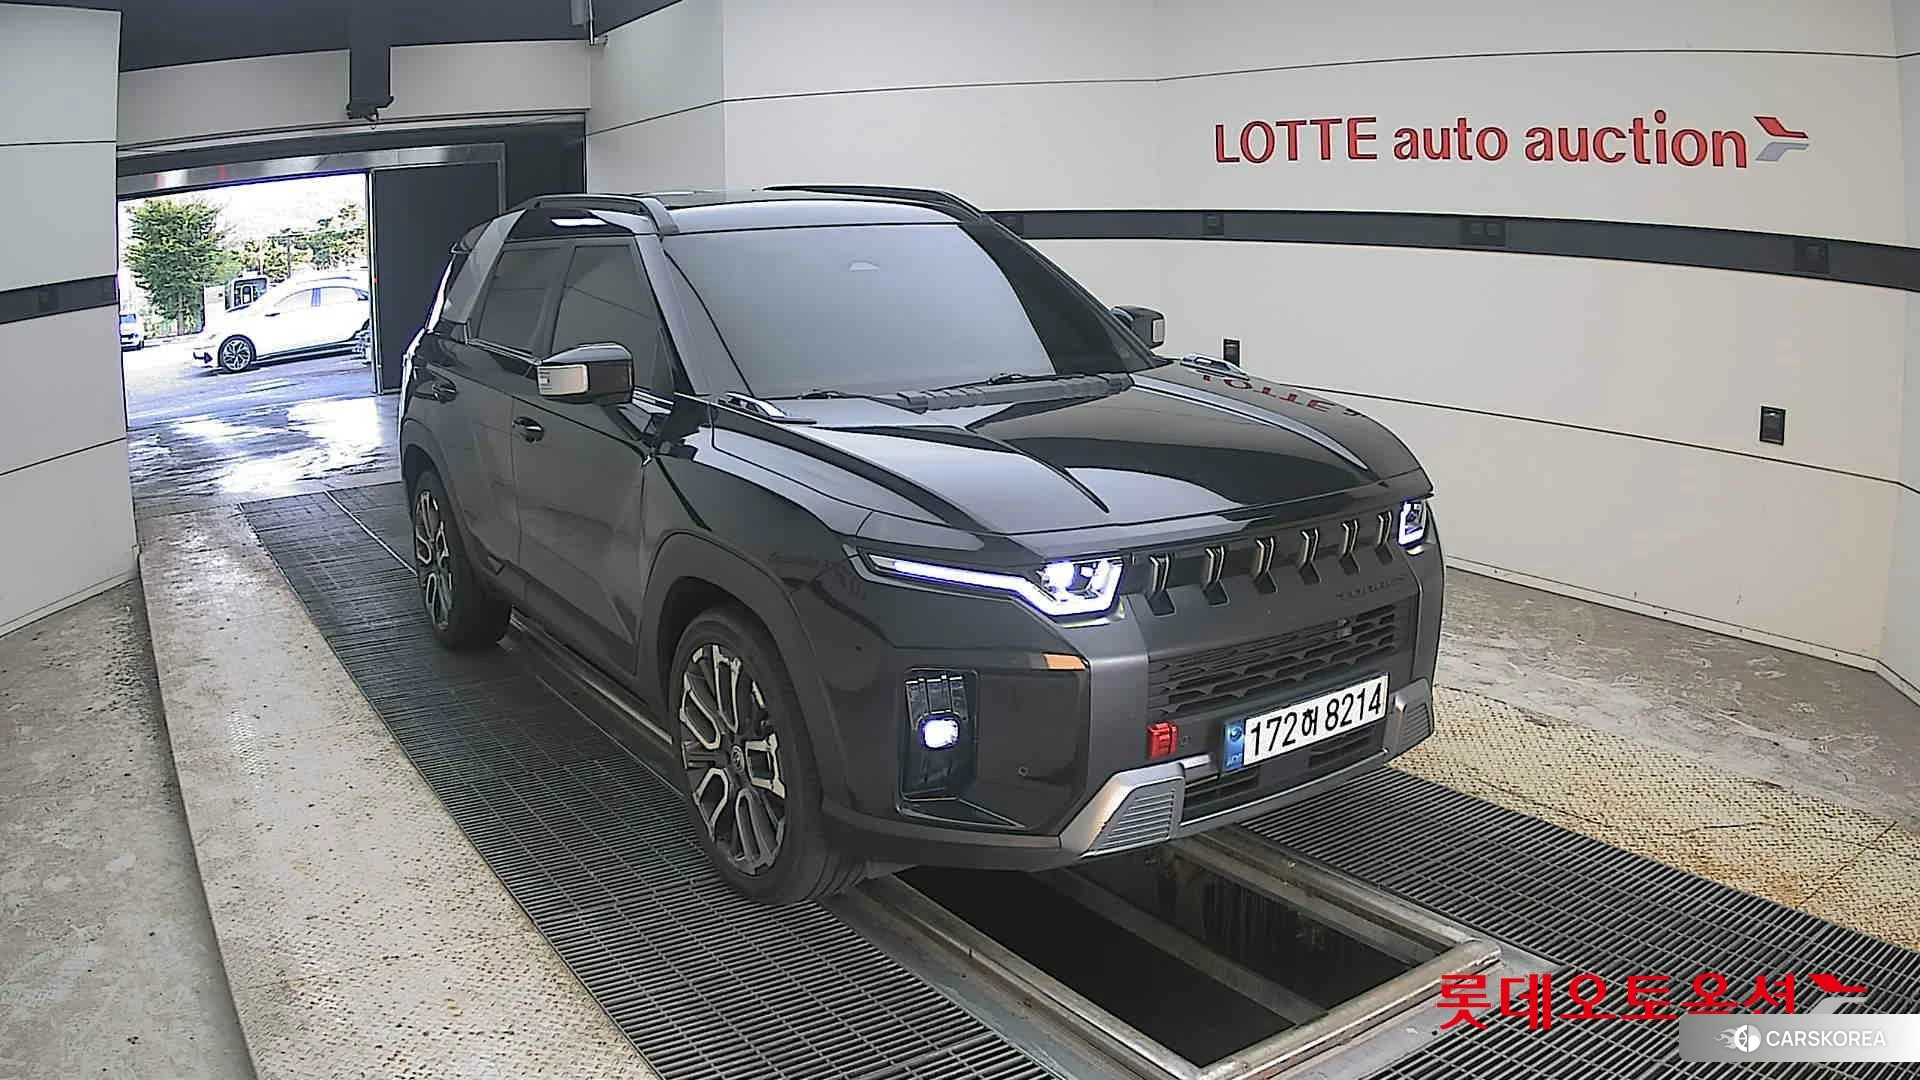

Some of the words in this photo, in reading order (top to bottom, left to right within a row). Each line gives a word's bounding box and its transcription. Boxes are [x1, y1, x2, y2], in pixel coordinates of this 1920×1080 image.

[1215, 118, 1377, 163] LOTTE
[1393, 117, 1508, 161] auto
[1525, 111, 1747, 168] auction
[1251, 706, 1318, 756] 172허
[1325, 683, 1381, 731] 8214
